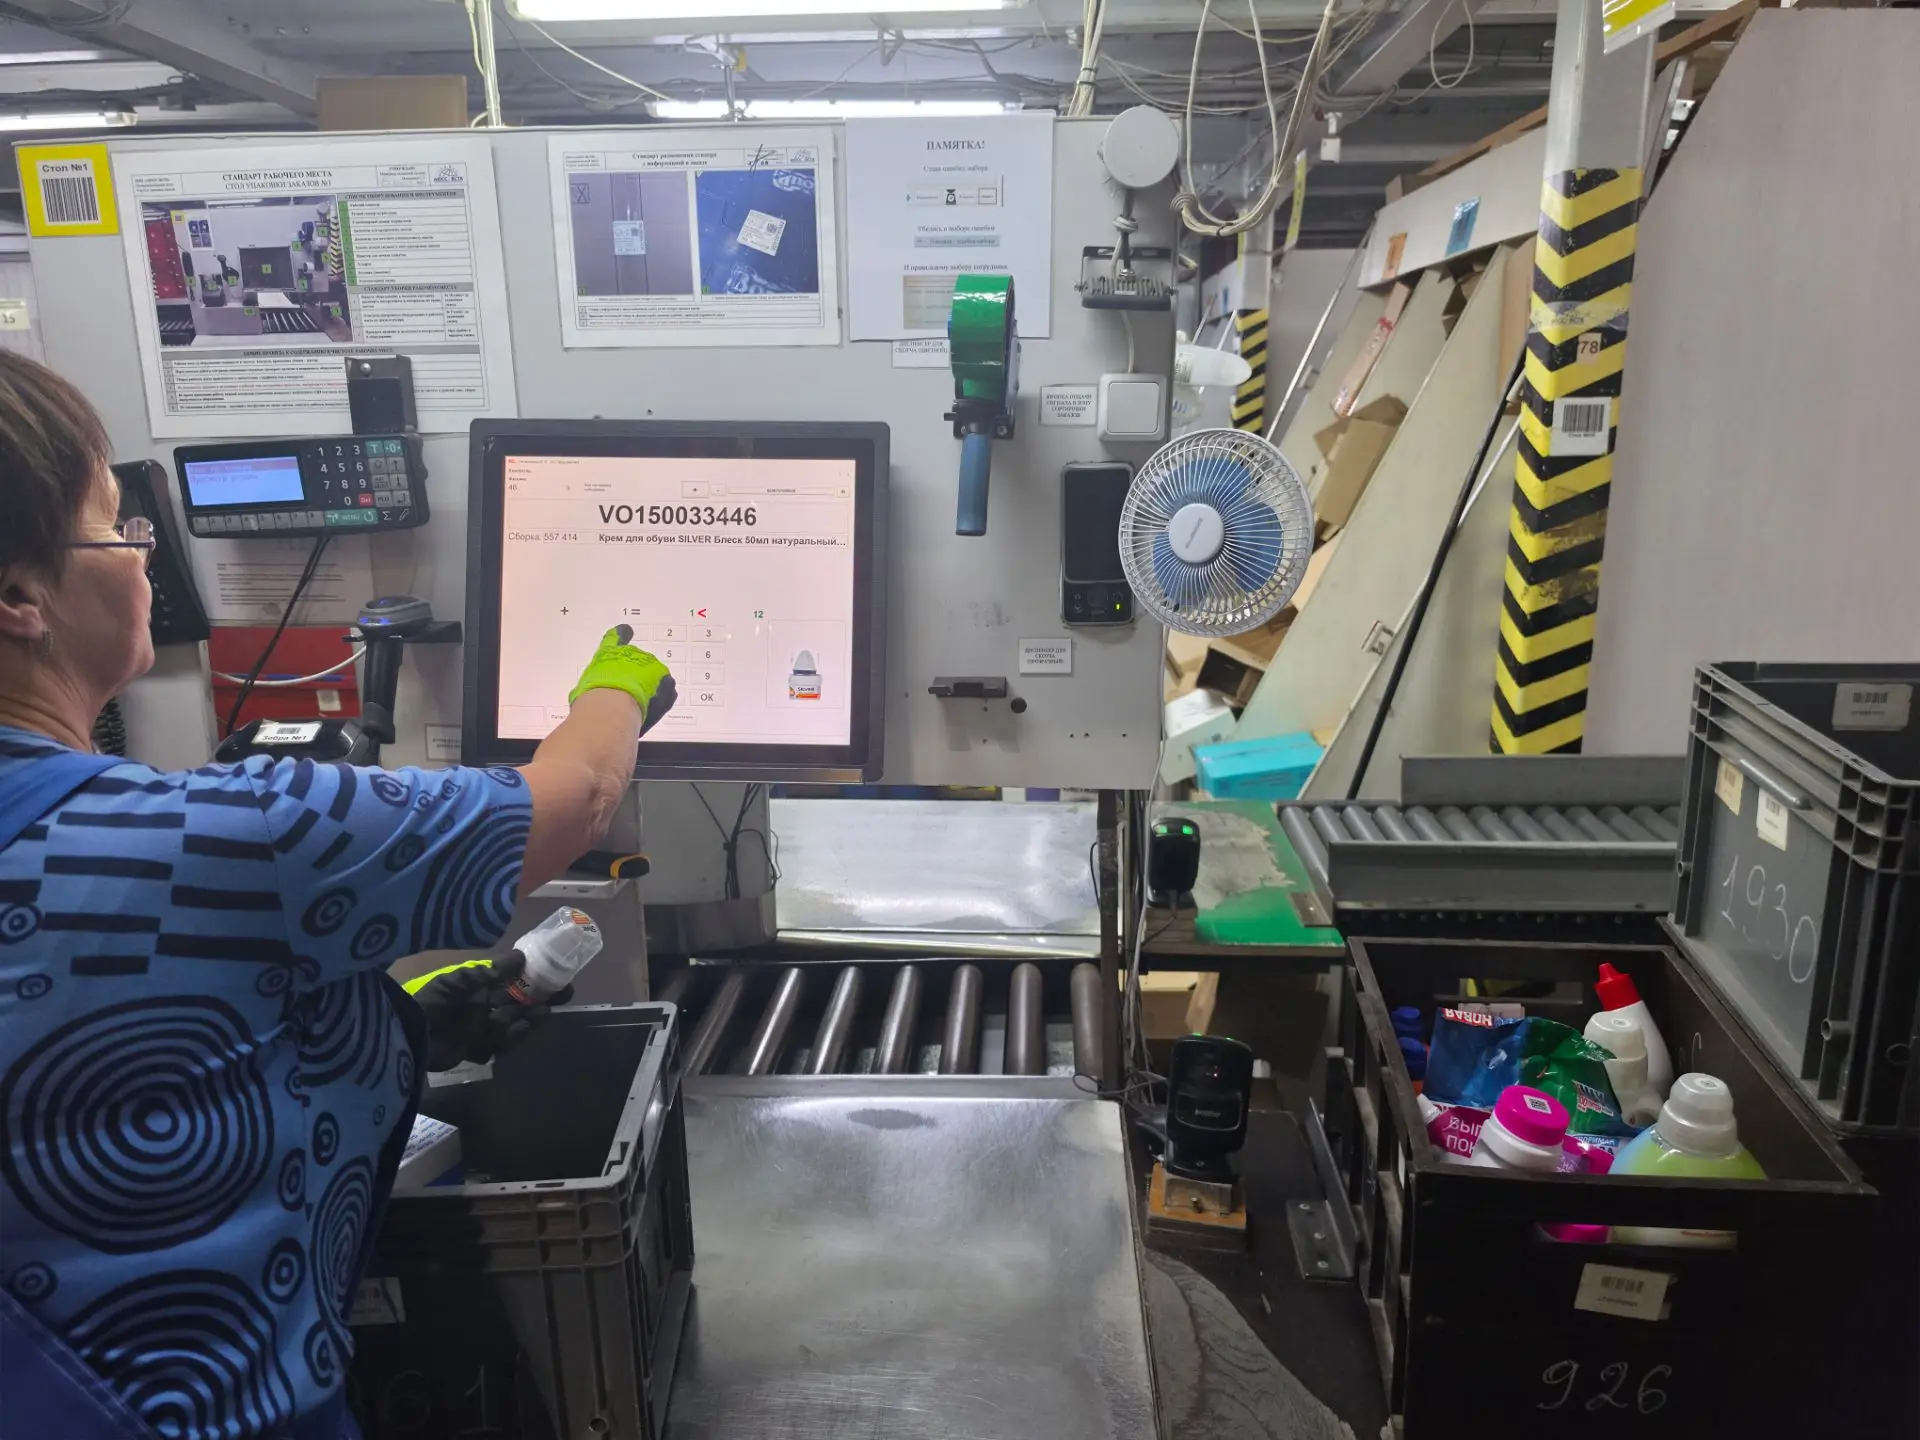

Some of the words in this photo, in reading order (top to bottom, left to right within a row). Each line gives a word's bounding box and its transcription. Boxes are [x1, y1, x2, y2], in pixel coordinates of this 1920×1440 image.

[926, 140, 986, 151] ПАМЯТКА!
[41, 164, 69, 174] Стол
[70, 163, 89, 173] №1
[222, 172, 262, 182] СТАНДАРТ
[264, 171, 304, 181] РАБОЧЕГО
[305, 170, 333, 179] МЕСТА
[225, 182, 247, 191] СТОЛ
[1580, 340, 1599, 354] 78
[318, 447, 324, 457] 1
[335, 446, 343, 456] 2
[353, 445, 361, 455] 3
[320, 464, 328, 473] 4
[338, 463, 346, 473] 5
[356, 462, 364, 472] 6
[323, 480, 330, 490] 7
[341, 480, 349, 489] 8
[359, 479, 367, 488] 9
[344, 496, 352, 506] 0
[599, 505, 757, 526] VO150033446
[543, 533, 559, 541] 557
[561, 533, 577, 541] 414
[599, 534, 623, 544] Крем
[625, 535, 644, 545] для
[646, 536, 676, 546] обуви
[678, 535, 712, 544] SILVER
[714, 536, 743, 545] Блеск
[745, 536, 769, 545] 50мл
[753, 610, 764, 619] 12
[667, 629, 673, 637] 2
[706, 629, 712, 638] 3
[666, 650, 672, 658] 5
[705, 651, 711, 659] 6
[705, 672, 711, 681] 9
[1721, 855, 1818, 983] 1930
[1536, 1359, 1672, 1414] 926
